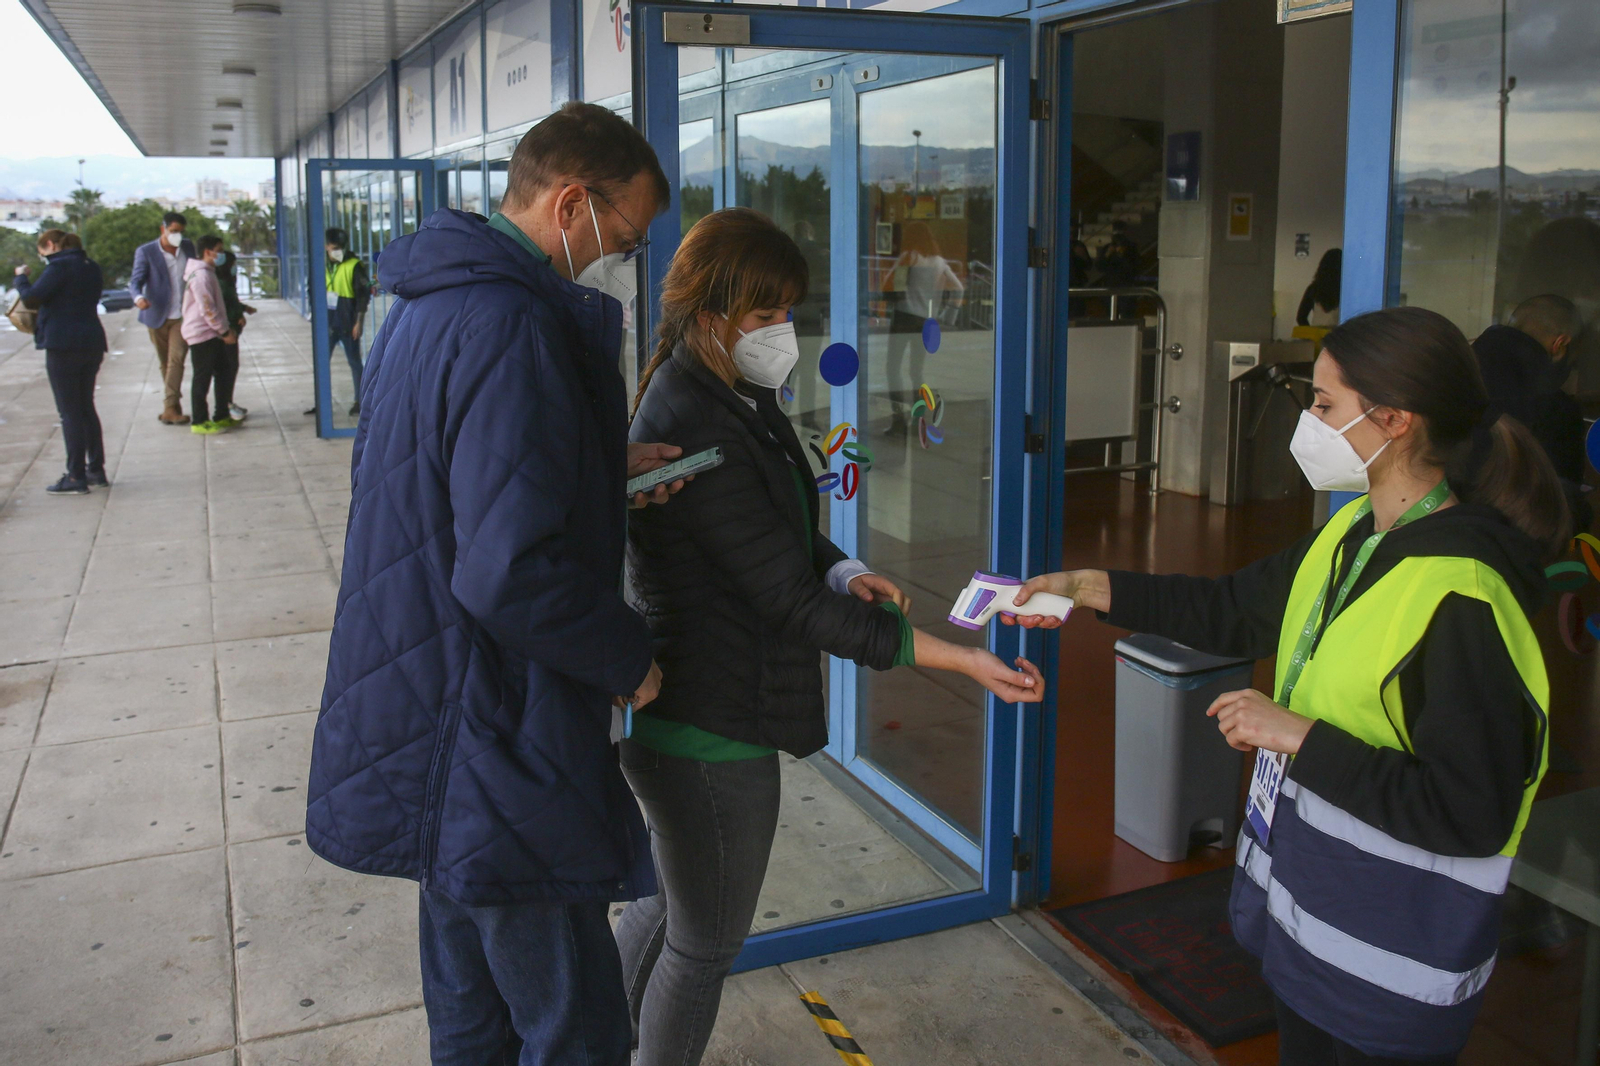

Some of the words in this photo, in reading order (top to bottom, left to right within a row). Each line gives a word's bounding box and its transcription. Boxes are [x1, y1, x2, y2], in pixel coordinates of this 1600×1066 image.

[450, 52, 467, 137] A1
[1116, 922, 1229, 1003] LIMPIEZA
[1146, 914, 1224, 964] ZONA
